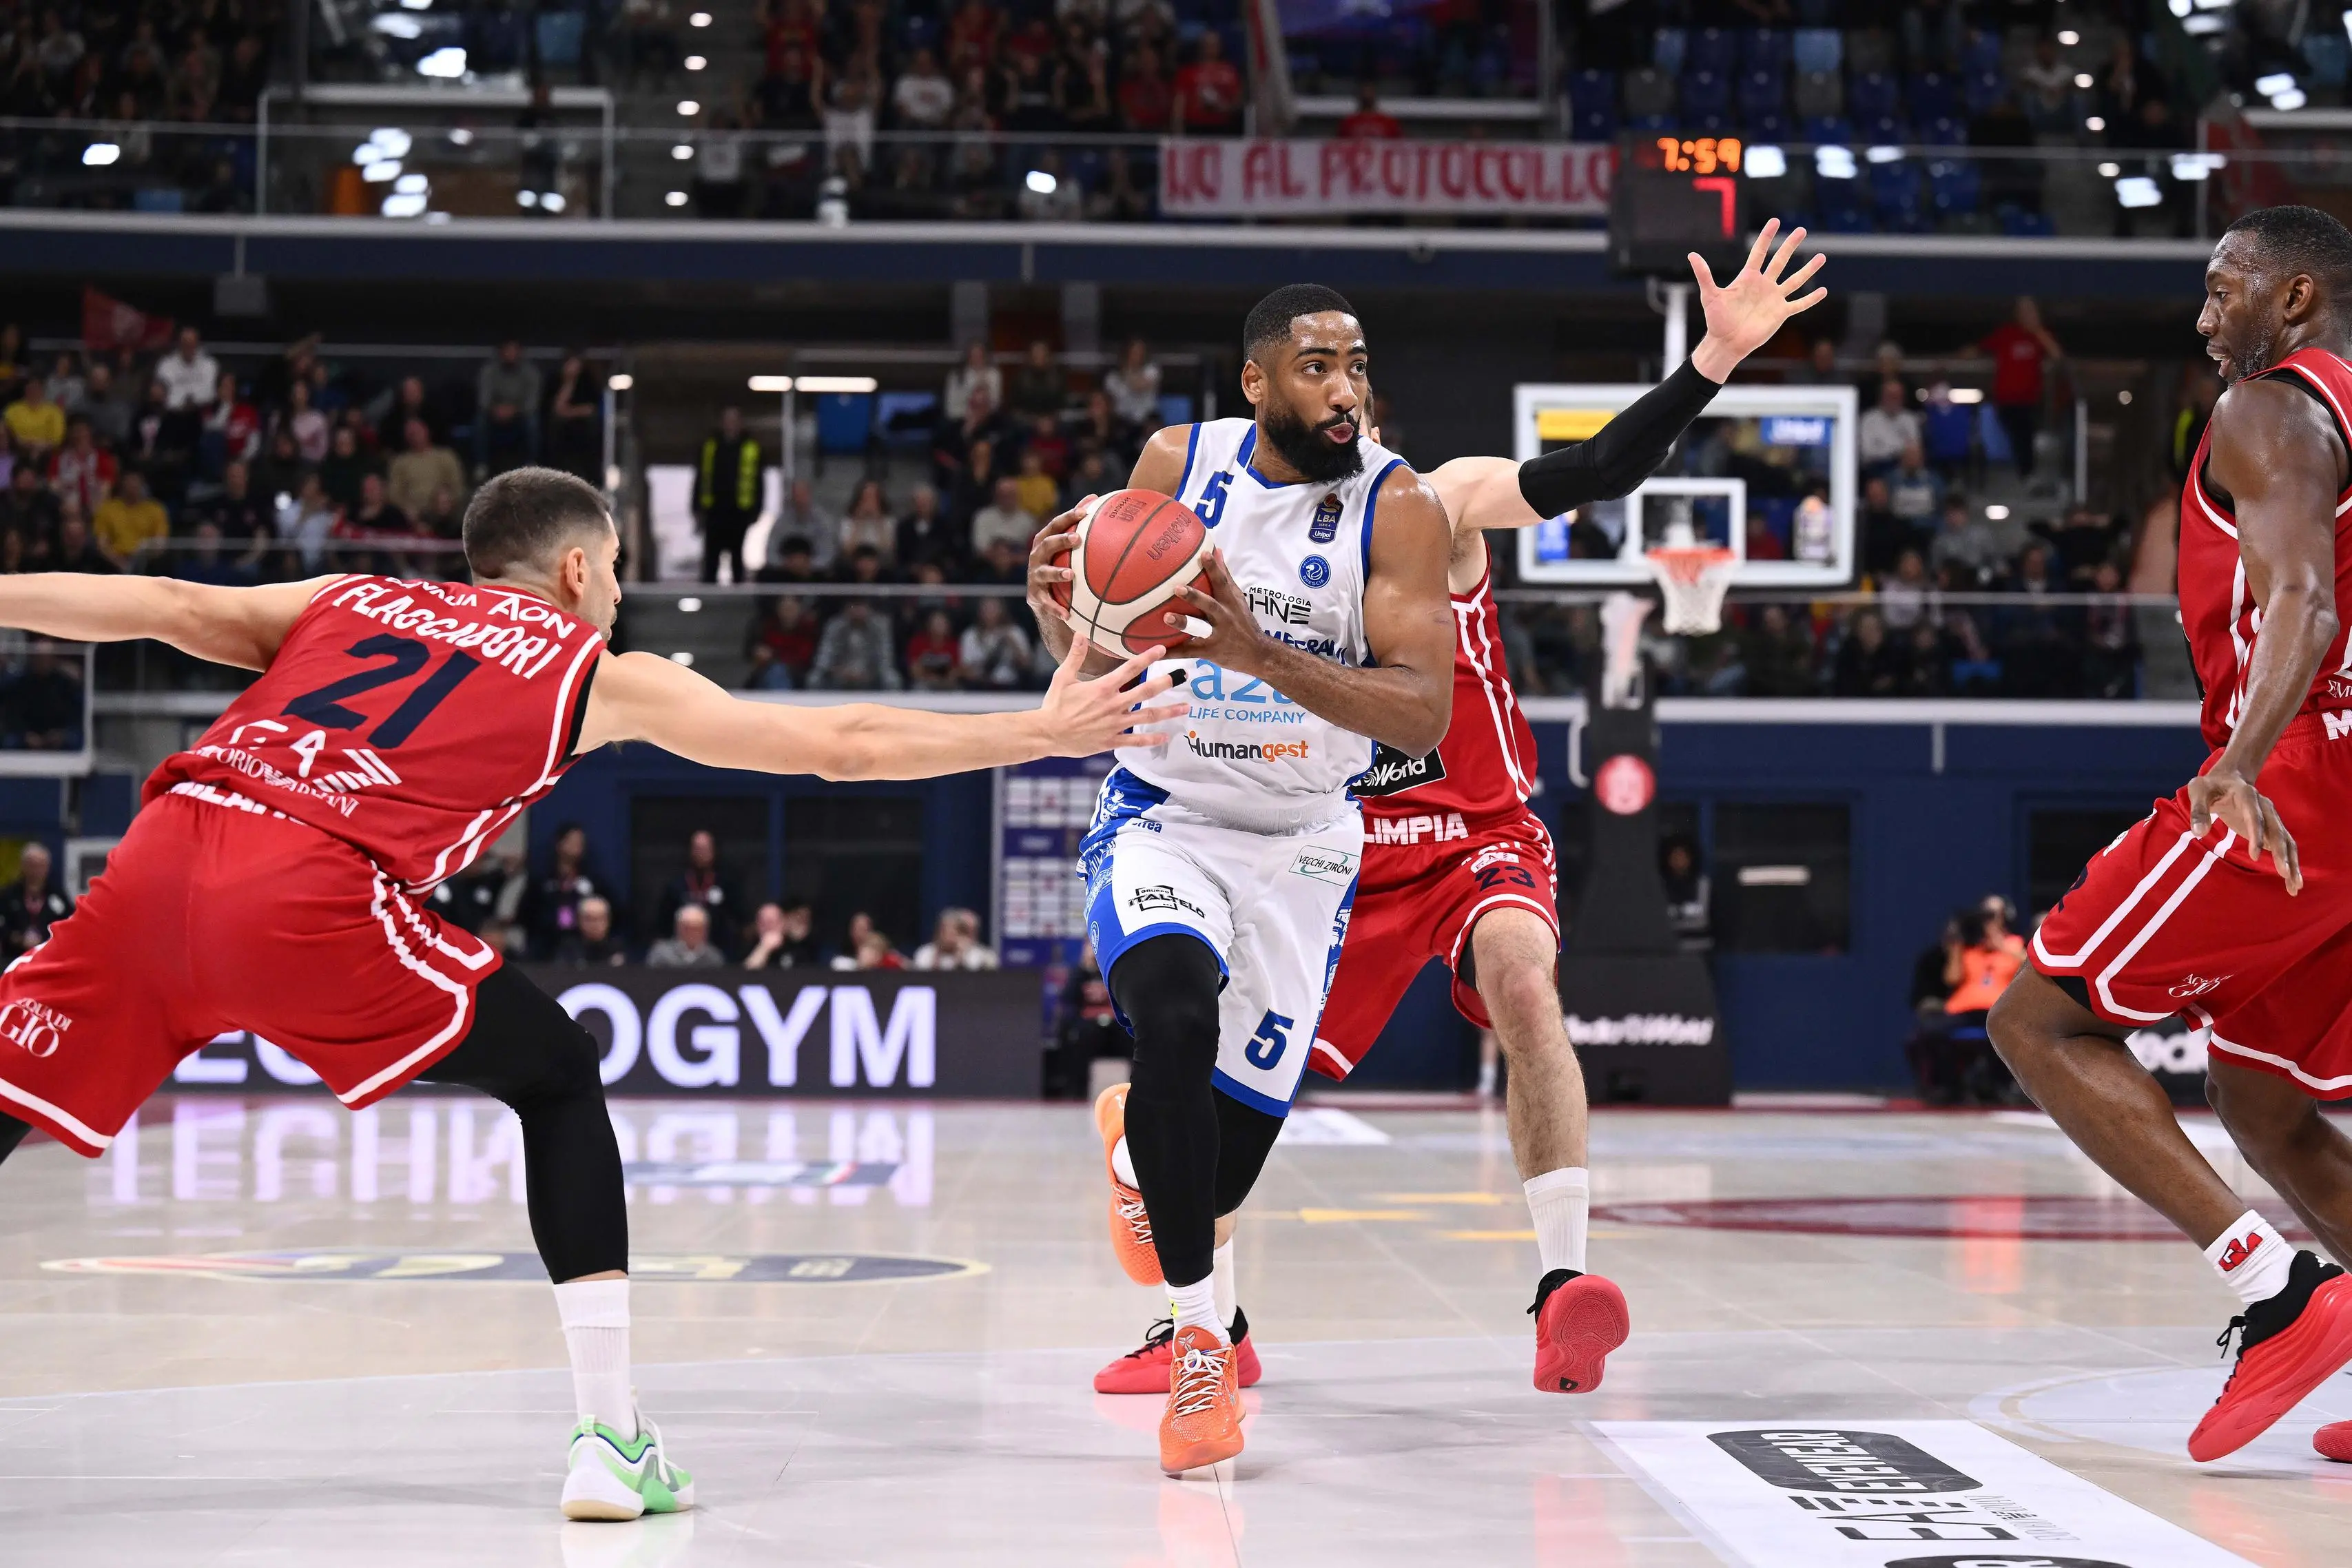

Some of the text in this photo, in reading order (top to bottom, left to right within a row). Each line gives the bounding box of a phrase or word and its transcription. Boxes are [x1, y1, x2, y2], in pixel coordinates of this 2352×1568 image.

[1242, 143, 1306, 202] AL
[1657, 137, 1742, 174] 7:59
[1692, 177, 1736, 240] 7
[1194, 471, 1235, 529] 5
[1146, 511, 1193, 561] molten
[1314, 530, 1332, 539] Unipol
[1317, 514, 1336, 524] LBA
[1249, 586, 1312, 608] METROLOGIA
[1302, 575, 1325, 586] BRESCIA
[487, 595, 577, 639] AON
[1243, 592, 1311, 625] HNE
[281, 632, 482, 750] 21
[1188, 707, 1306, 724] LIFE COMPANY
[1184, 730, 1309, 762] Humangest
[1298, 855, 1353, 876] VECCHI ZIRONI
[1474, 865, 1536, 892] 23
[1244, 1008, 1294, 1072] 5
[1760, 1432, 1928, 1490] EYEWEAR
